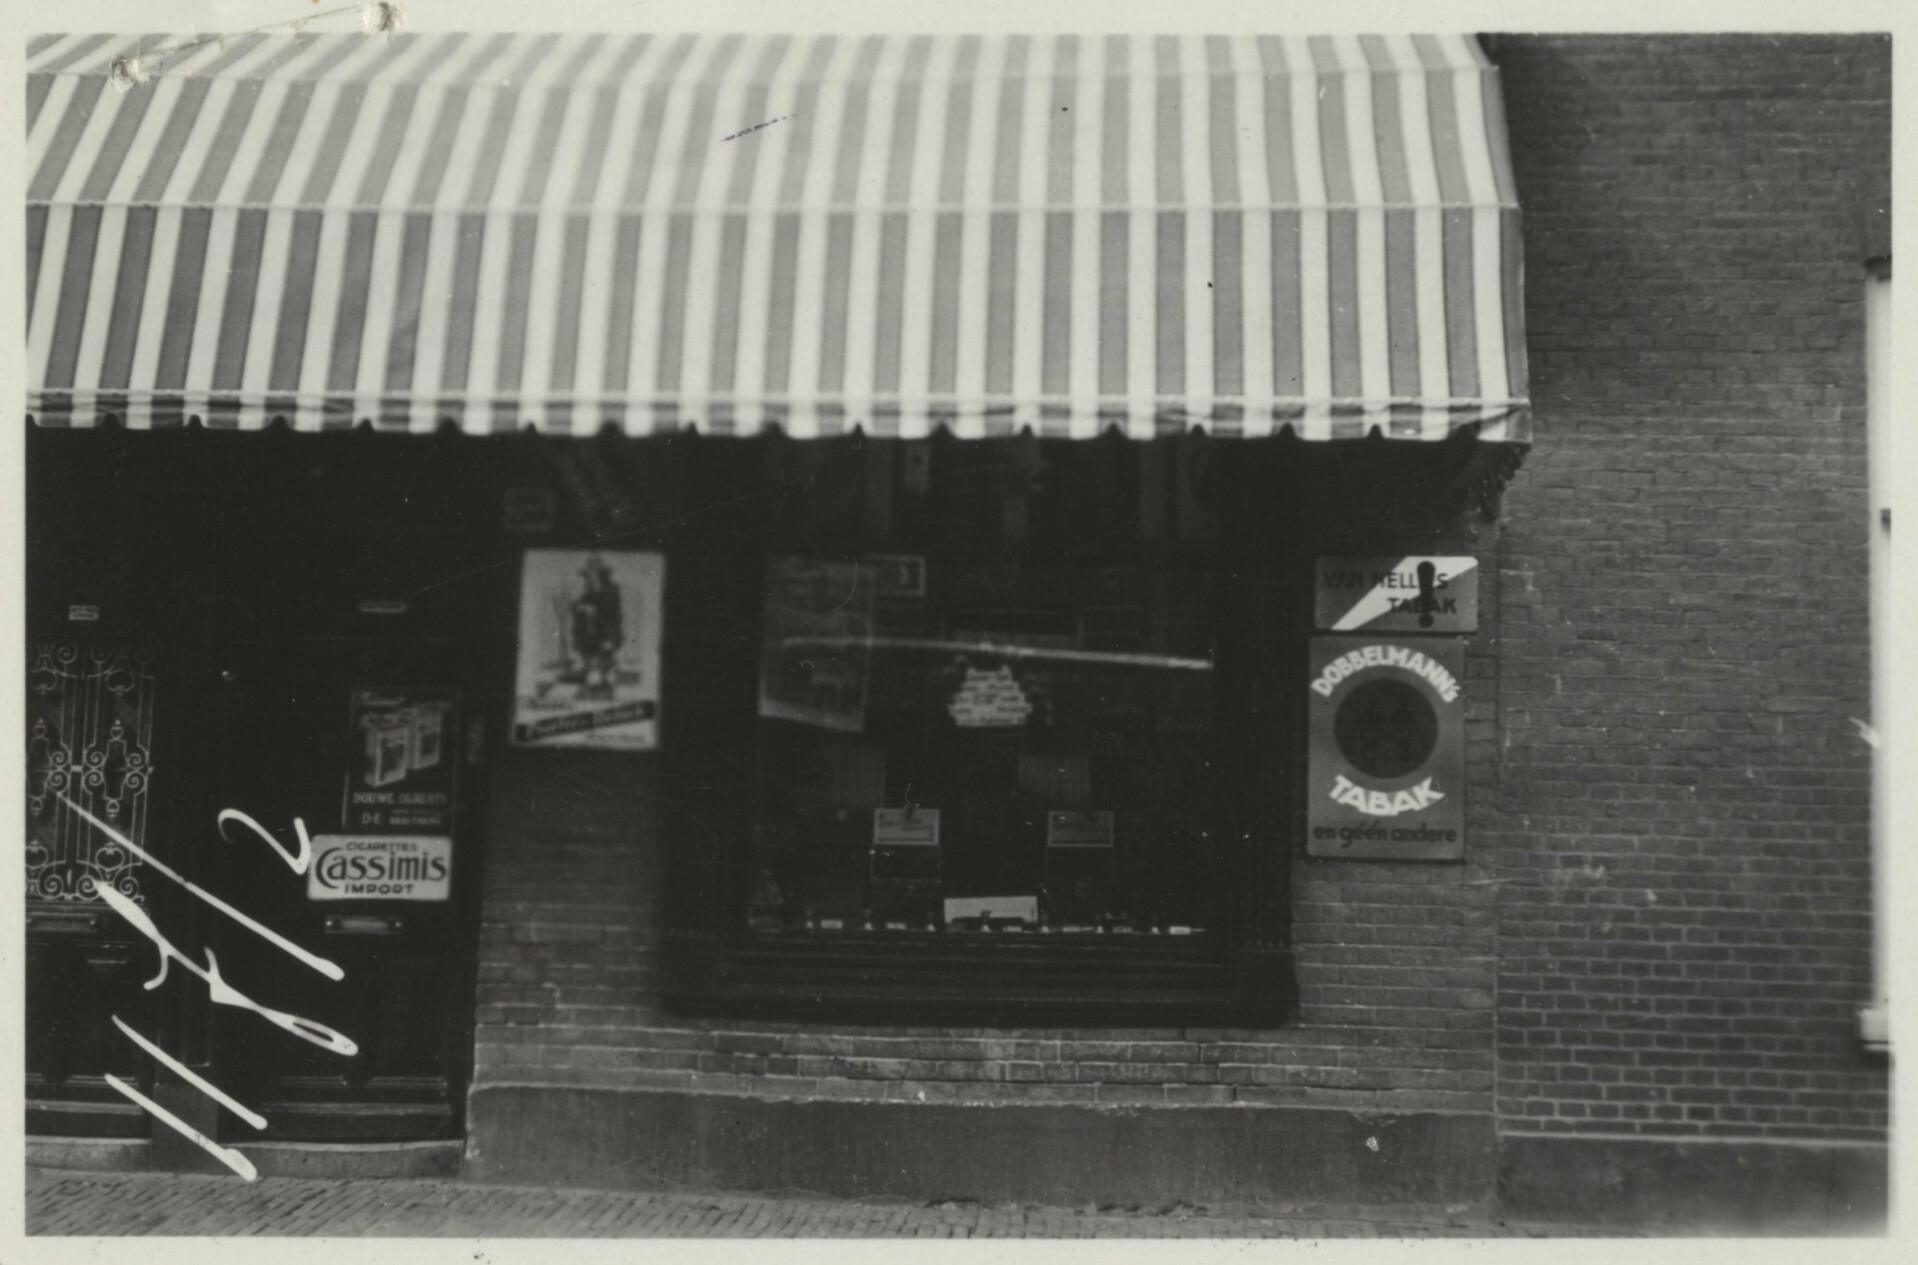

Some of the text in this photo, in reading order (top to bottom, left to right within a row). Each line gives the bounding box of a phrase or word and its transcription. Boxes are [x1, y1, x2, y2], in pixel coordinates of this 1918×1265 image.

[1323, 570, 1363, 588] VAN
[353, 792, 395, 804] DOUWE
[1329, 774, 1445, 816] TABAK
[1314, 826, 1337, 839] en
[1390, 821, 1458, 842] andere
[346, 841, 418, 852] CIGARETTES
[315, 847, 447, 890] Cassimis
[344, 884, 413, 895] IMPORT
